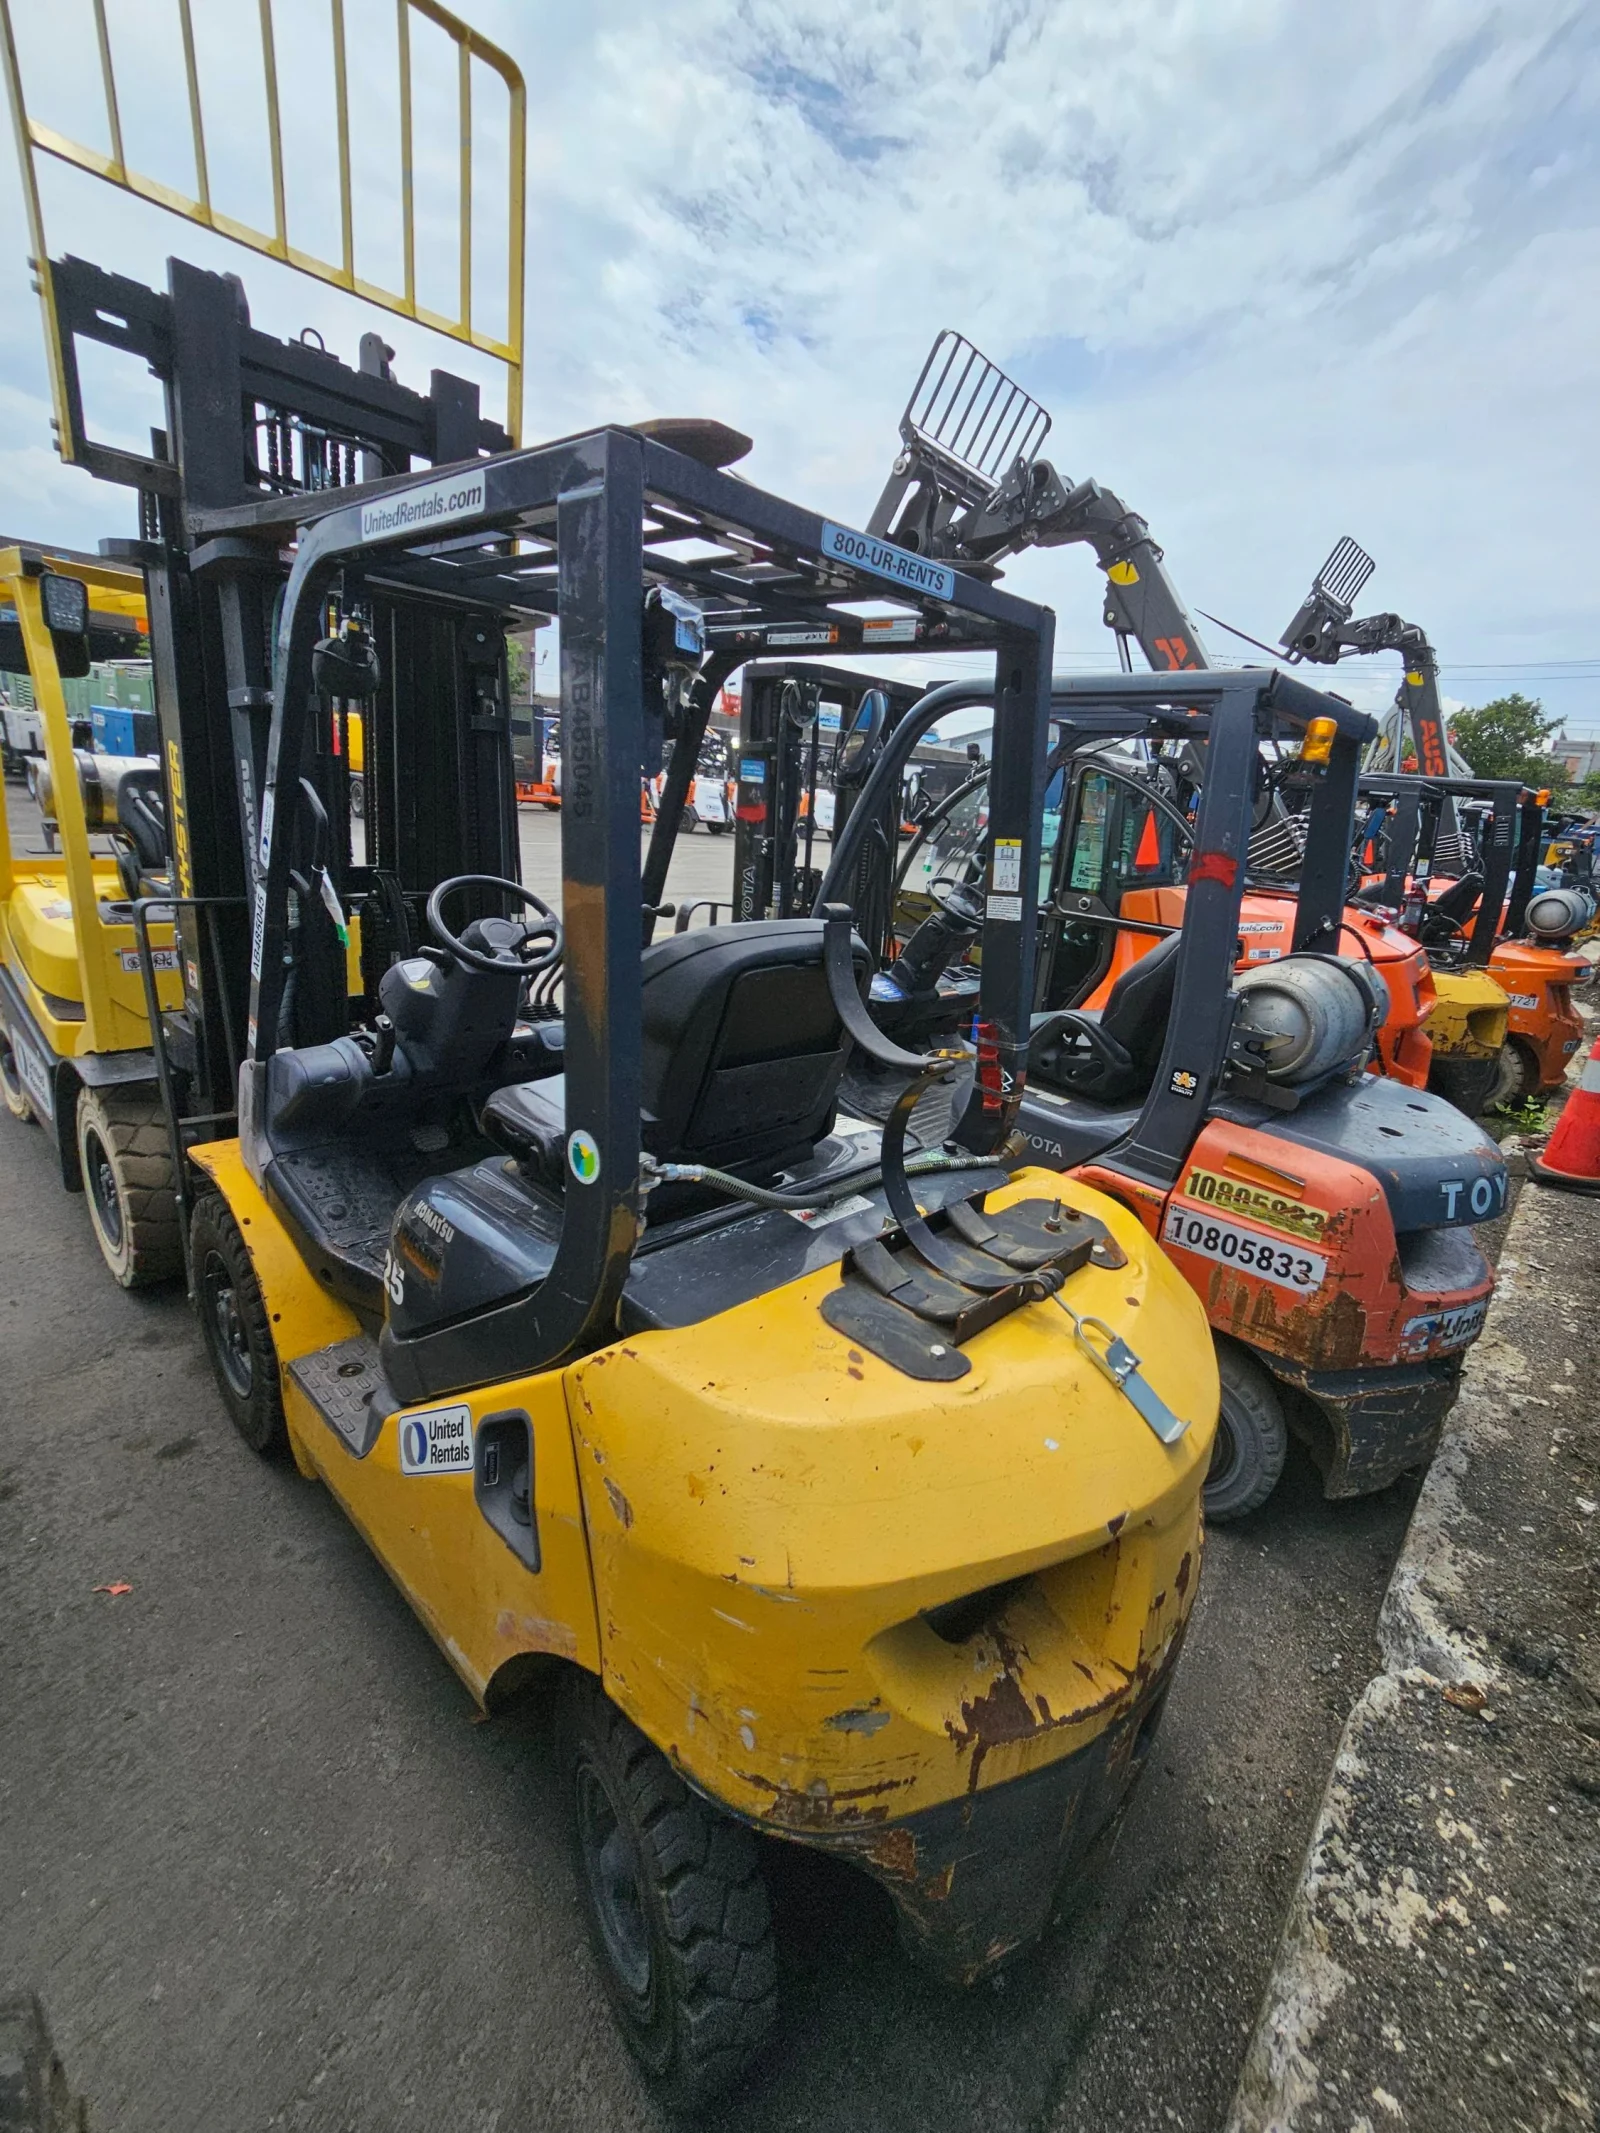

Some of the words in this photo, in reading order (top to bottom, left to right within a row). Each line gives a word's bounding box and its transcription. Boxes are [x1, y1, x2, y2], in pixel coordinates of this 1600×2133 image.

[364, 486, 482, 535] UnitedRentals.com
[833, 532, 945, 591] 800-UR-RENTS
[571, 655, 593, 818] AB485045
[168, 740, 191, 899] HYSTER
[240, 759, 259, 887] OMATSU
[252, 894, 265, 975] AB485045
[1172, 1071, 1197, 1088] SAS
[414, 1200, 455, 1243] KOMATSU
[1173, 1216, 1313, 1286] 10805833
[429, 1416, 464, 1441] United
[430, 1440, 470, 1464] Rentals
